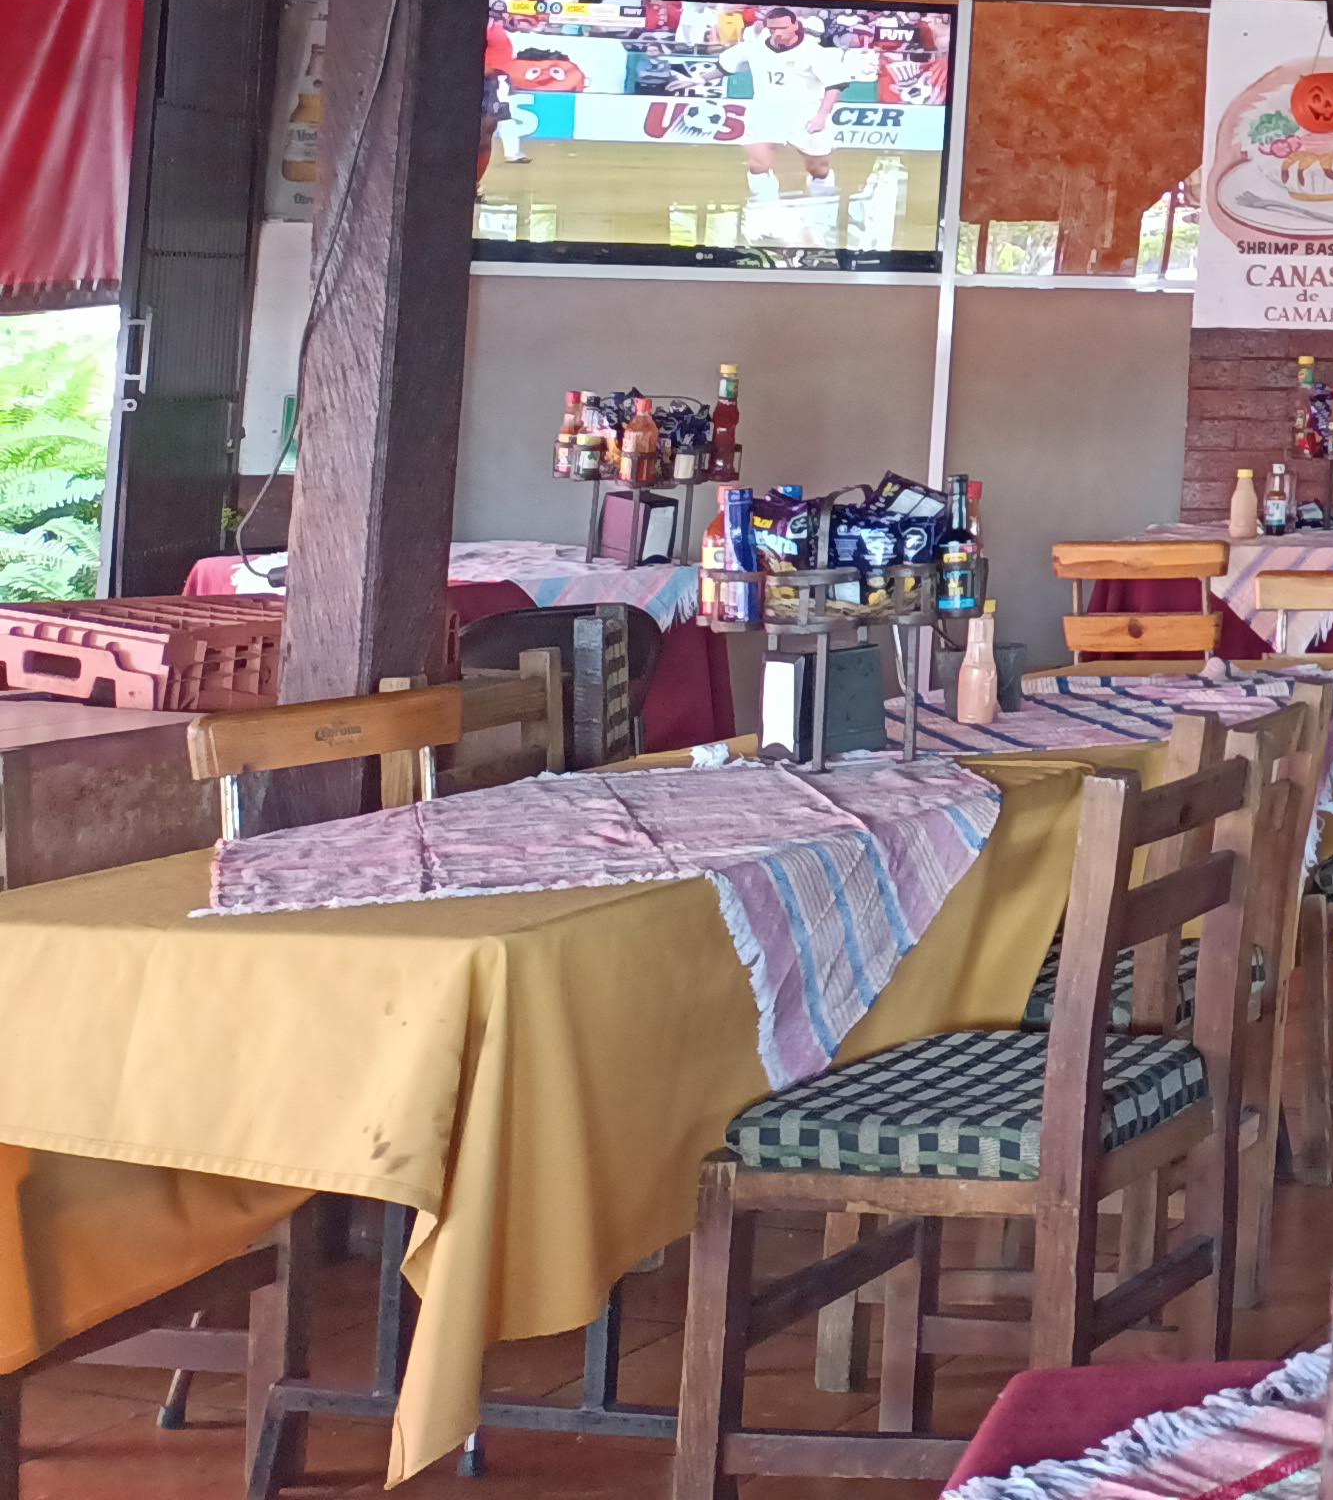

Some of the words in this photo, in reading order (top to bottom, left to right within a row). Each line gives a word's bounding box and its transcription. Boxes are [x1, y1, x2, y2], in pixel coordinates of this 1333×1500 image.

[878, 27, 914, 42] FUTV
[768, 71, 785, 86] 12
[1237, 240, 1299, 256] SHRIMP
[1296, 289, 1320, 303] de
